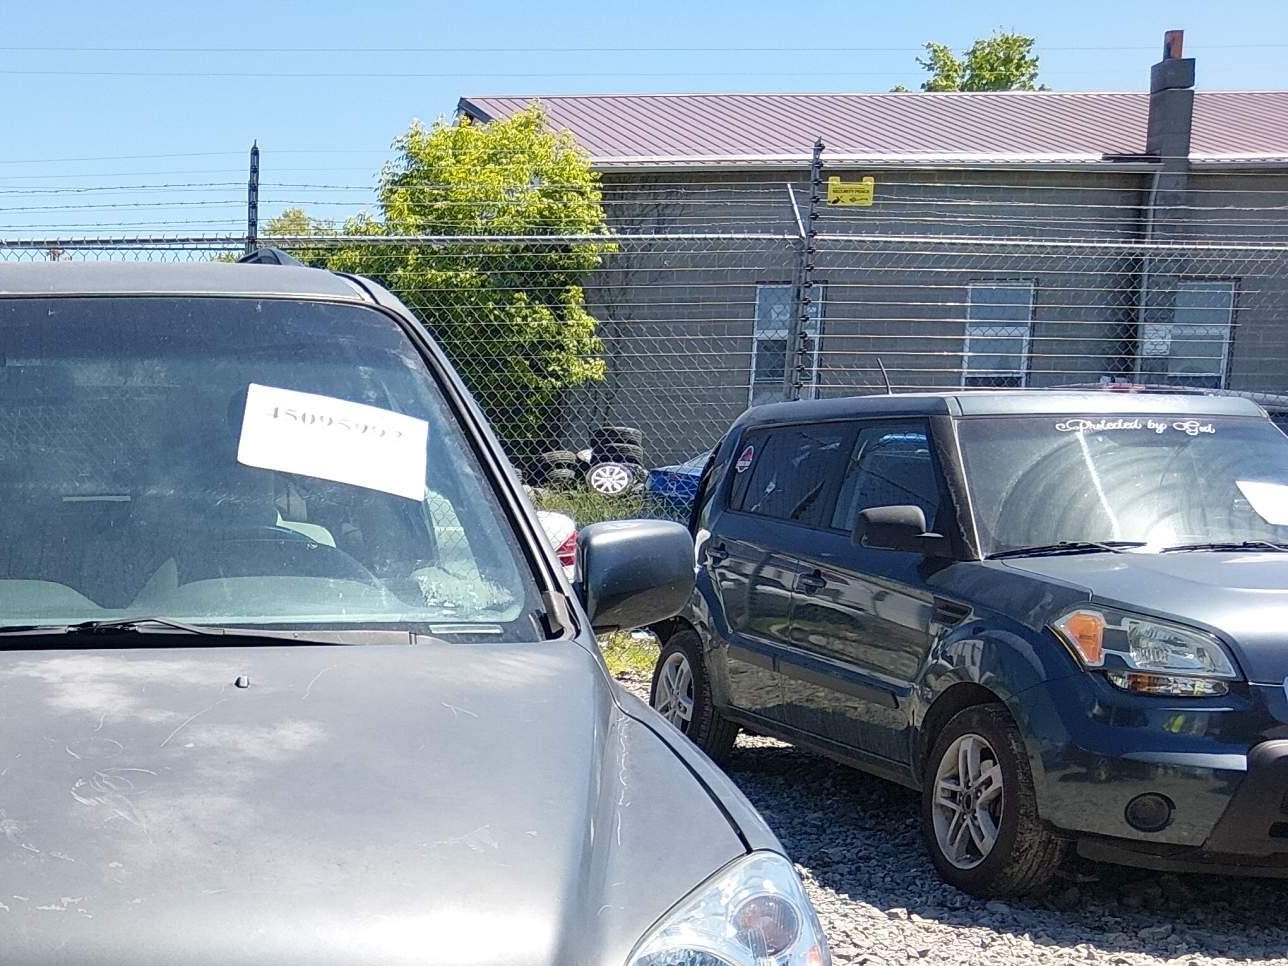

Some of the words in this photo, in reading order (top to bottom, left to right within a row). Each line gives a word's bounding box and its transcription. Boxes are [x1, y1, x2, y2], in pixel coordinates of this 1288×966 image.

[1056, 419, 1142, 432] Protected
[1147, 420, 1166, 433] by
[1173, 421, 1215, 435] God
